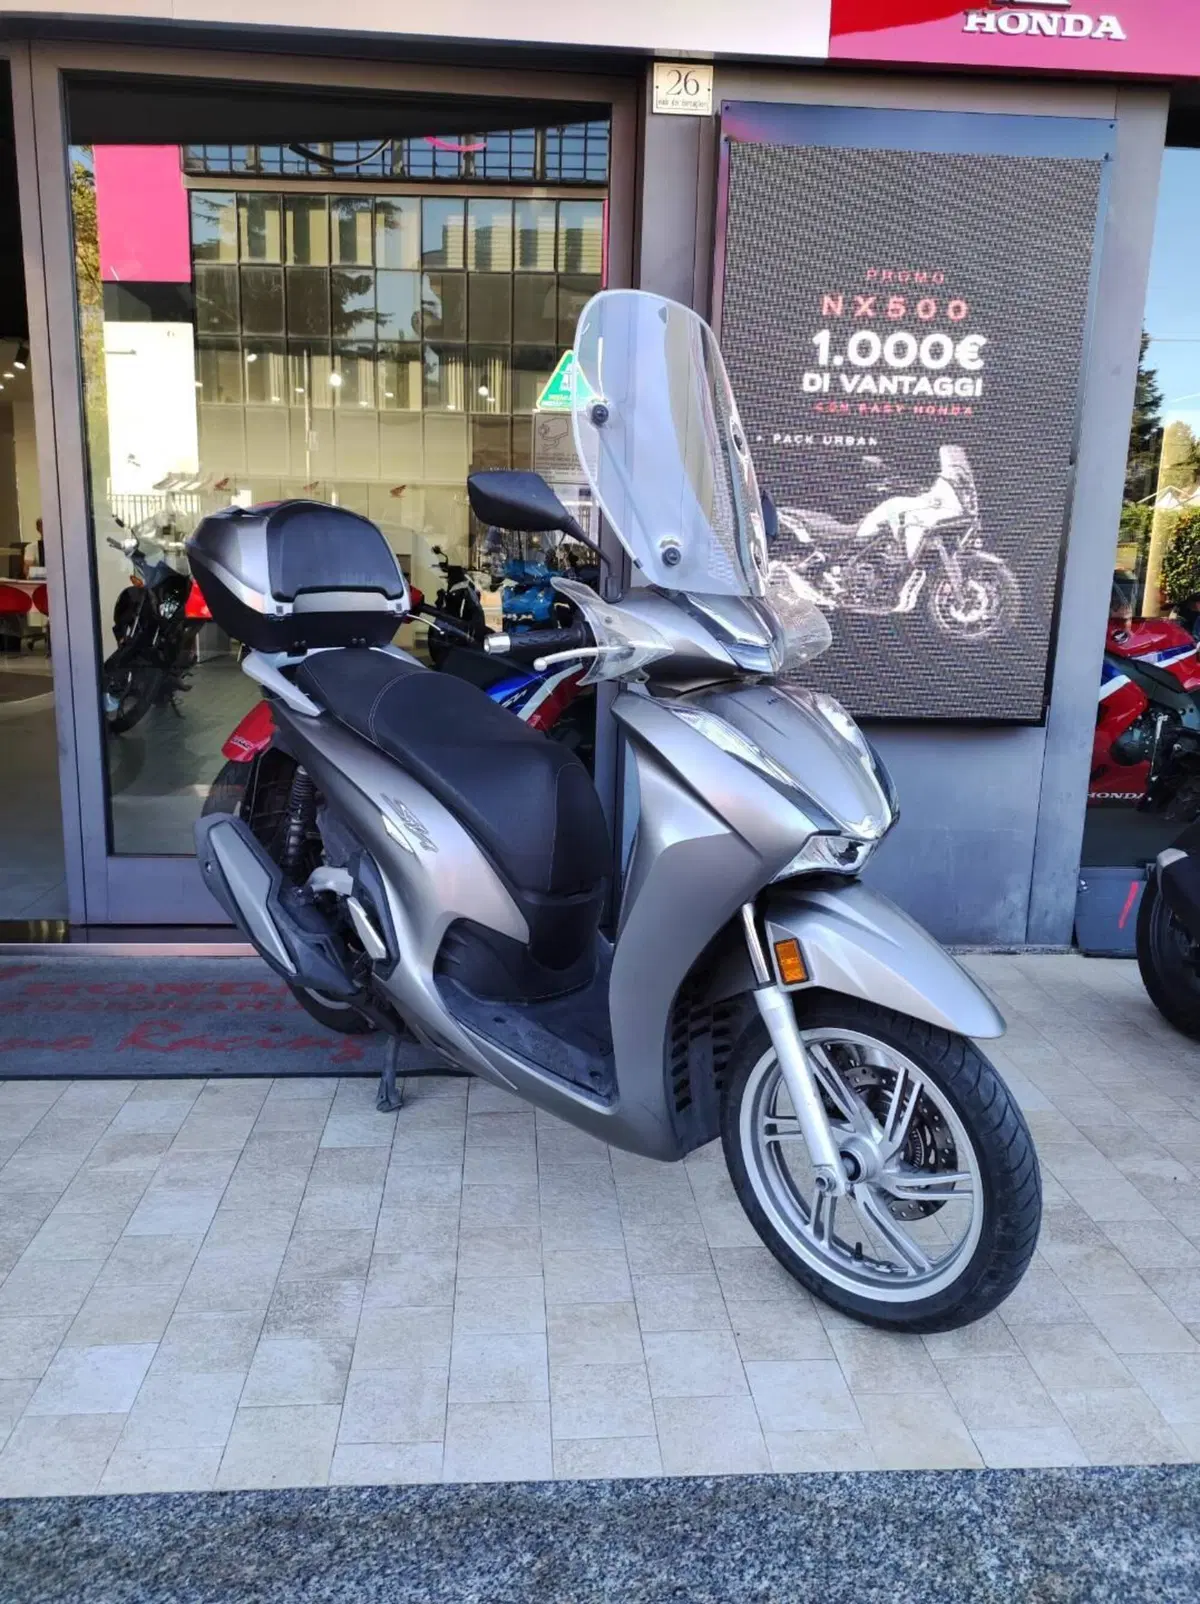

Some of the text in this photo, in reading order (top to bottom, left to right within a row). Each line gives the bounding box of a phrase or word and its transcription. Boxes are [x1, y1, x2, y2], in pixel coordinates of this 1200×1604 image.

[962, 11, 1127, 40] HONDA
[666, 69, 699, 96] 26
[866, 267, 944, 284] PROMO
[821, 293, 969, 321] NX500
[812, 329, 987, 370] 1.000€
[802, 372, 983, 397] DI VANTAGGI
[814, 402, 849, 414] CON
[913, 405, 973, 416] HONDA
[773, 433, 878, 446] PACK URBAN
